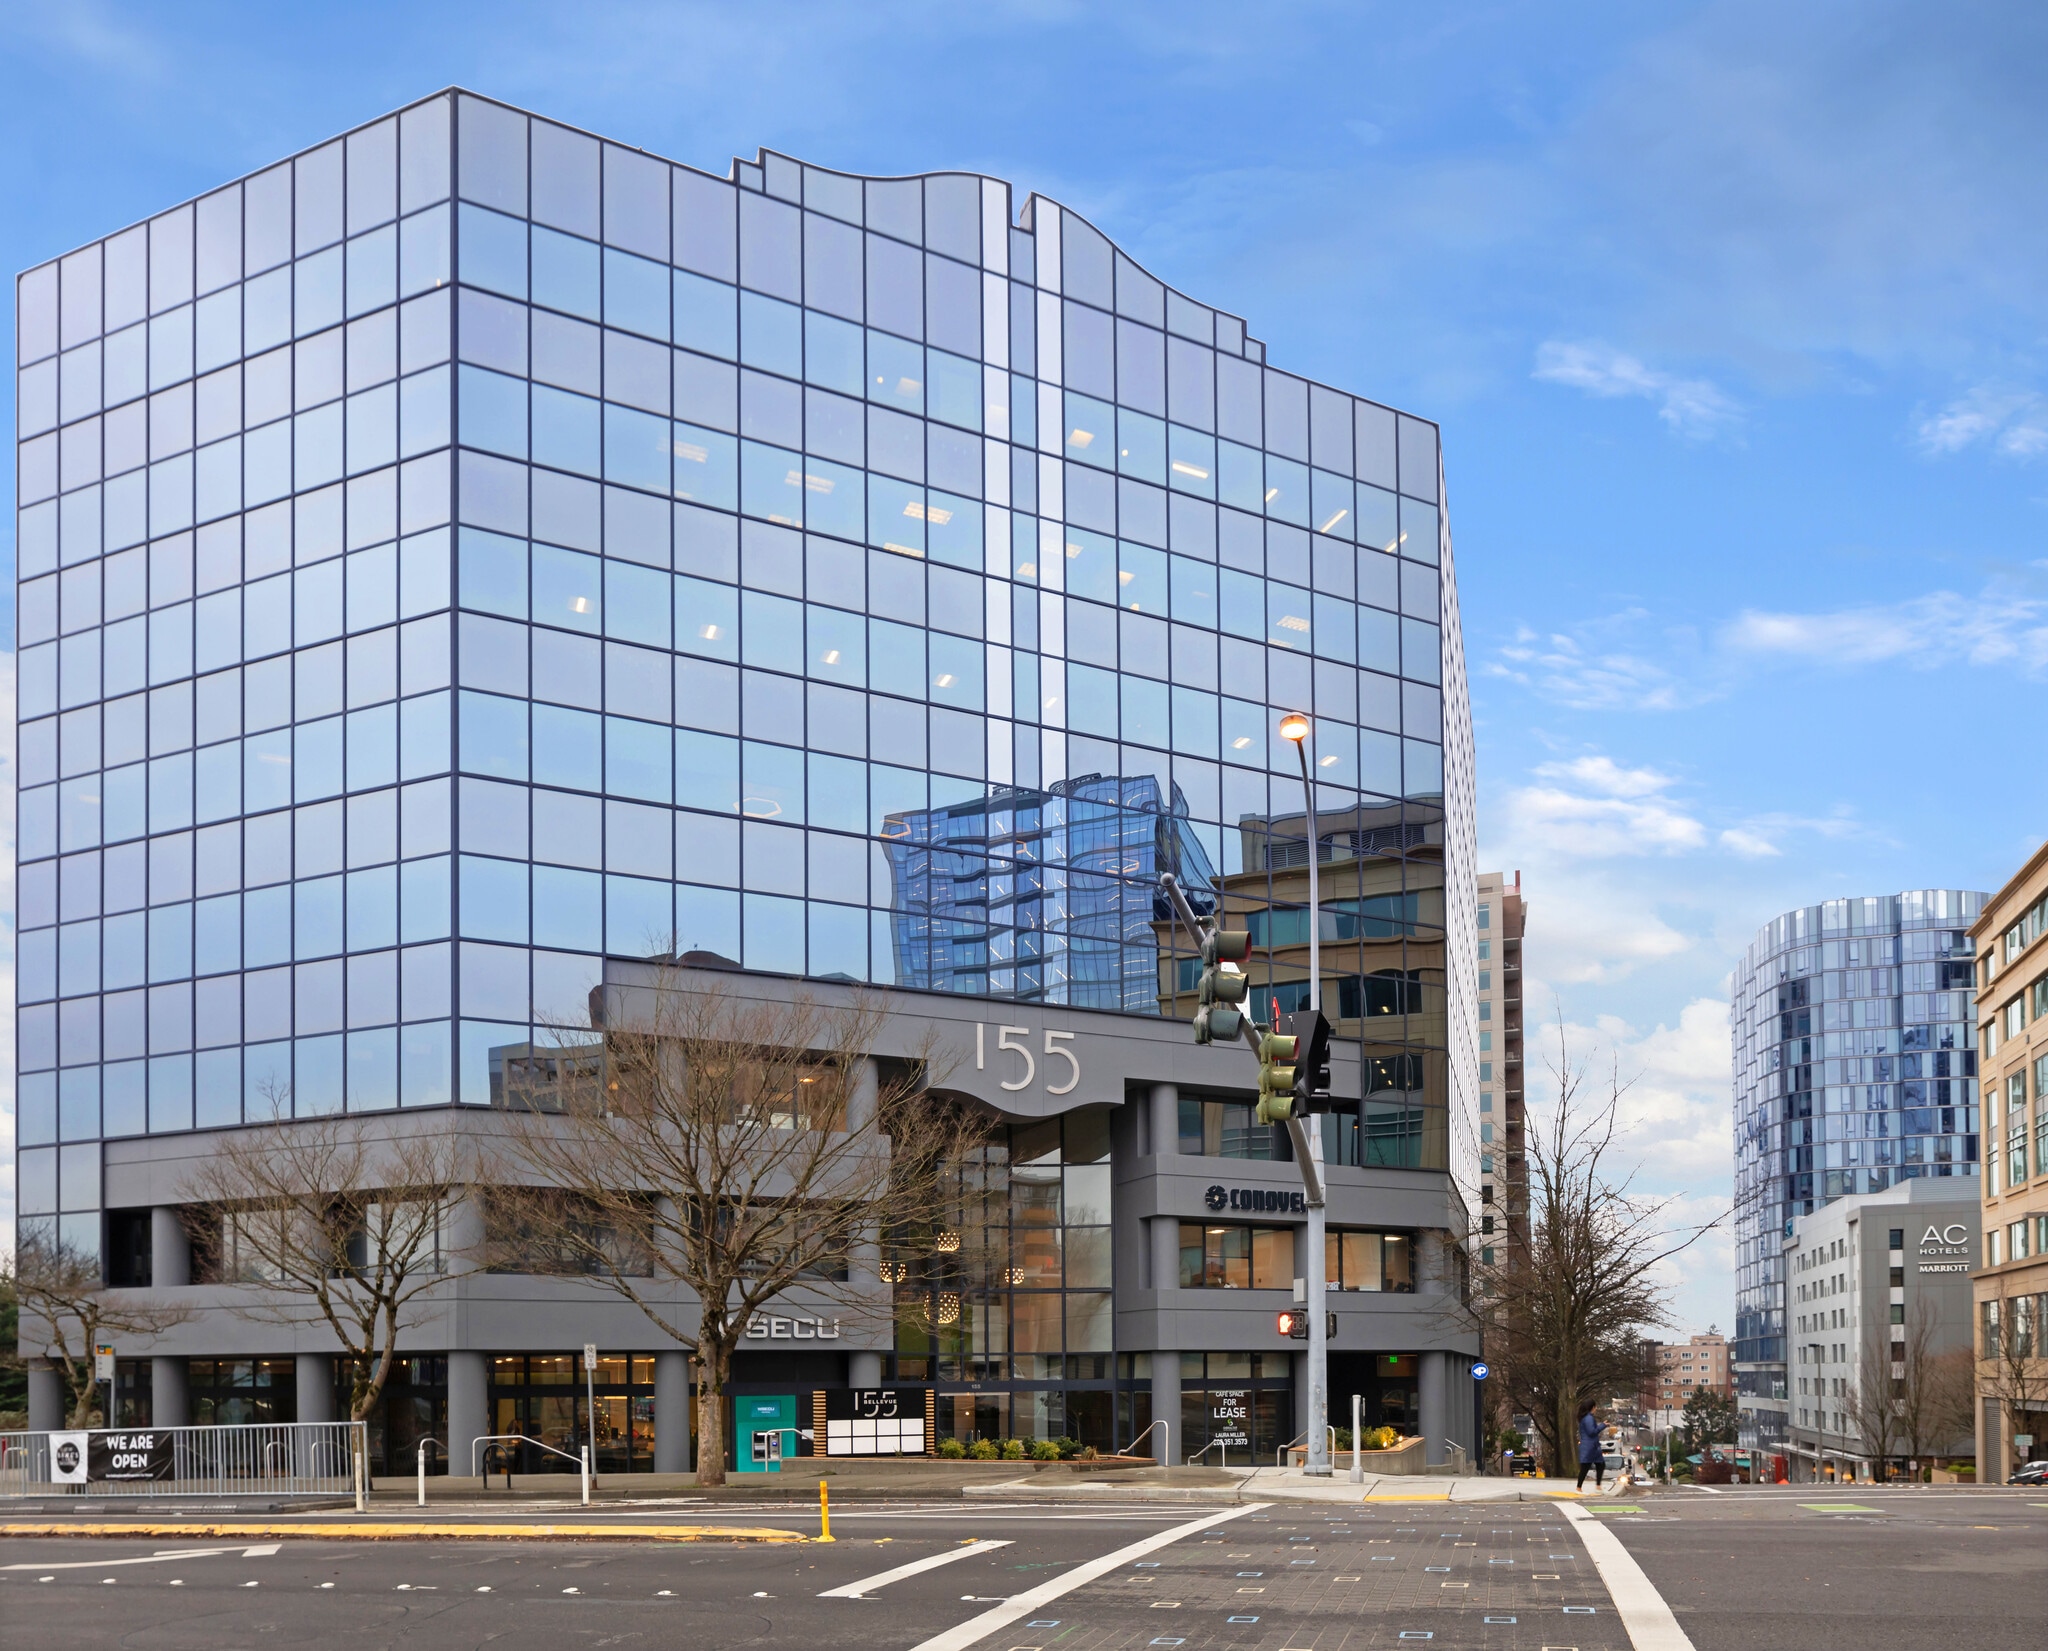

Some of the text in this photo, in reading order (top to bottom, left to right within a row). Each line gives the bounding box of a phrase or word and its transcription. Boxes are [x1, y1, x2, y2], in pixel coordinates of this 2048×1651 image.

[977, 1022, 1080, 1095] 155
[1920, 1224, 1968, 1245] AC
[1919, 1247, 1969, 1255] HOTELS
[1919, 1264, 1970, 1273] MARRIOTT
[854, 1391, 898, 1417] 155
[1223, 1398, 1237, 1406] FOR
[1213, 1407, 1246, 1418] LEASE
[106, 1435, 154, 1450] WE ARE
[112, 1453, 148, 1468] OPEN
